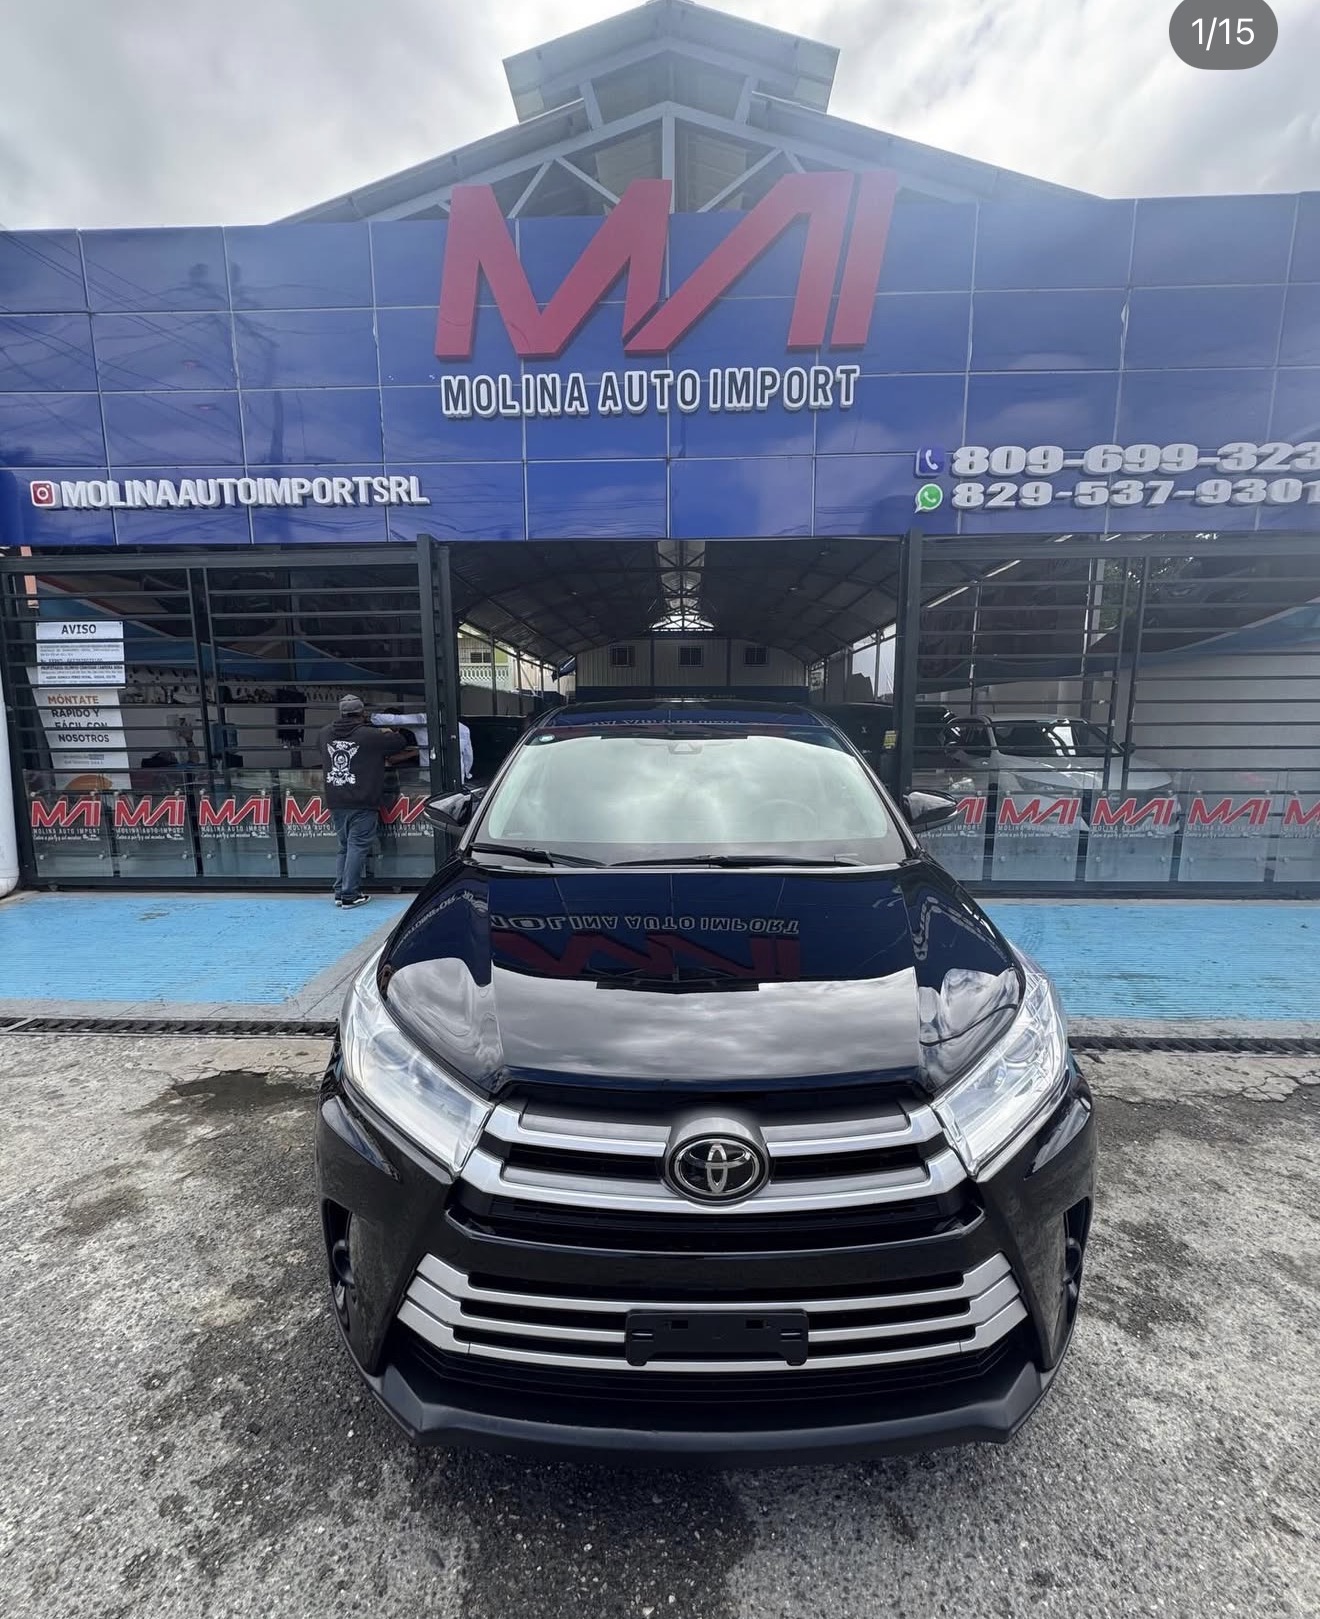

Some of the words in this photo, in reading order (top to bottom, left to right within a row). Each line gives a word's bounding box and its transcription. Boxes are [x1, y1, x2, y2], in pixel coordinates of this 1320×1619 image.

[434, 171, 898, 360] MAI
[440, 374, 590, 418] MOLINA
[598, 370, 701, 415] AUTO
[709, 365, 860, 412] IMPORT
[952, 442, 1320, 477] 809-699-323
[60, 476, 431, 508] MOLINAAUTOIMPORTSRL
[952, 478, 1320, 510] 829-537-9301
[61, 624, 97, 635] AVISO
[47, 693, 100, 704] MÓNTATE
[93, 708, 100, 717] Y
[58, 733, 110, 742] NOSOTROS
[31, 800, 102, 828] MAI
[114, 799, 187, 827] MAI
[199, 798, 271, 826] MAI
[998, 797, 1081, 825] MAI
[1091, 797, 1175, 825] MAI
[1187, 797, 1272, 826] MAI
